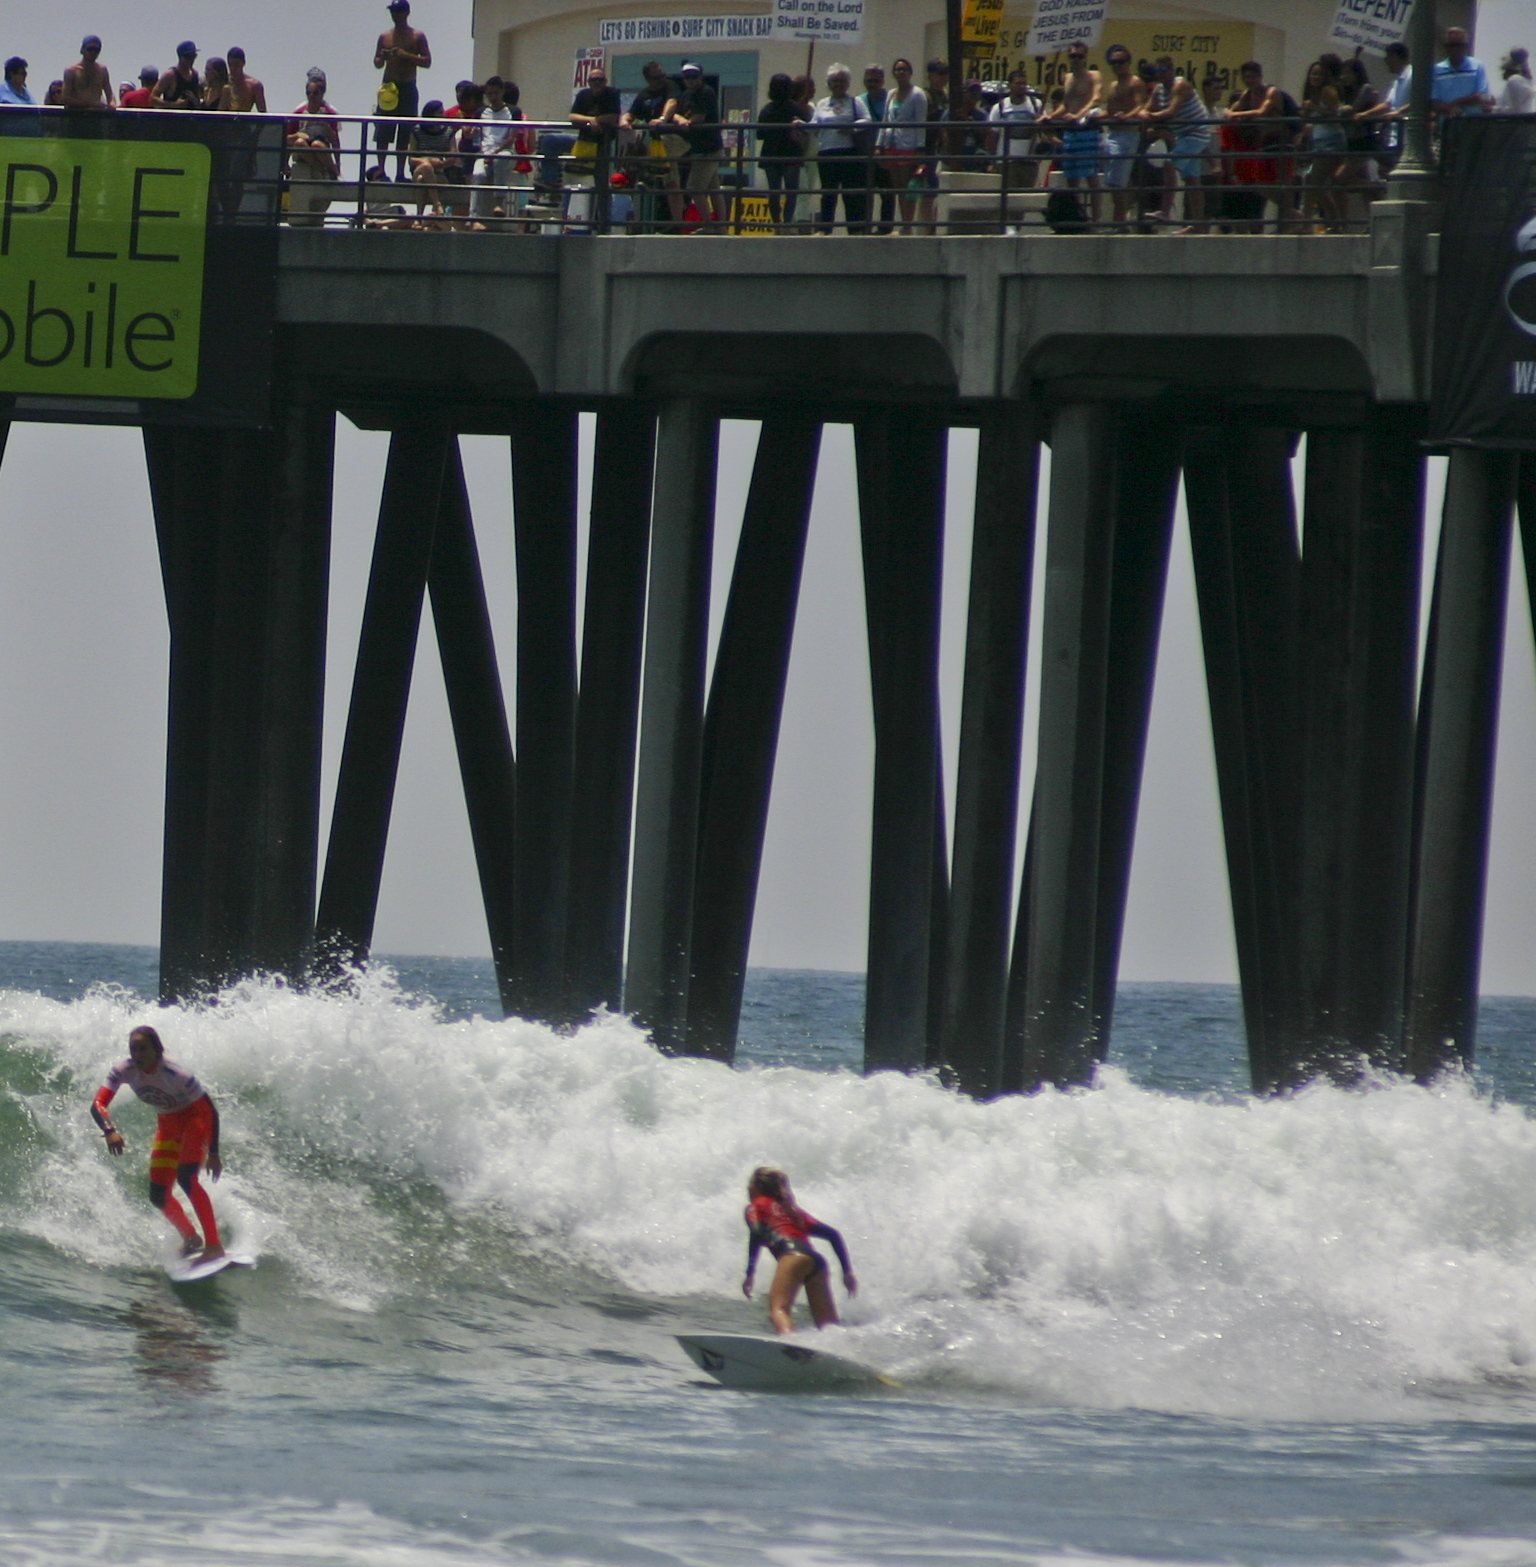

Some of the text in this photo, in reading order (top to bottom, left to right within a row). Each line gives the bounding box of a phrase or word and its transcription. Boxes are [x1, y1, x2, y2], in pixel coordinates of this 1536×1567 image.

[778, 0, 863, 14] Call on the Lord
[777, 15, 859, 31] Shall Be Saved.
[1072, 9, 1104, 23] FROM
[601, 21, 622, 41] LET'S
[625, 20, 635, 39] GO
[638, 19, 671, 39] FISHING
[682, 19, 703, 38] SURF
[706, 18, 725, 37] CITY
[727, 17, 755, 37] SNACK
[1037, 30, 1057, 43] THE
[1151, 35, 1220, 53] SURF CITY
